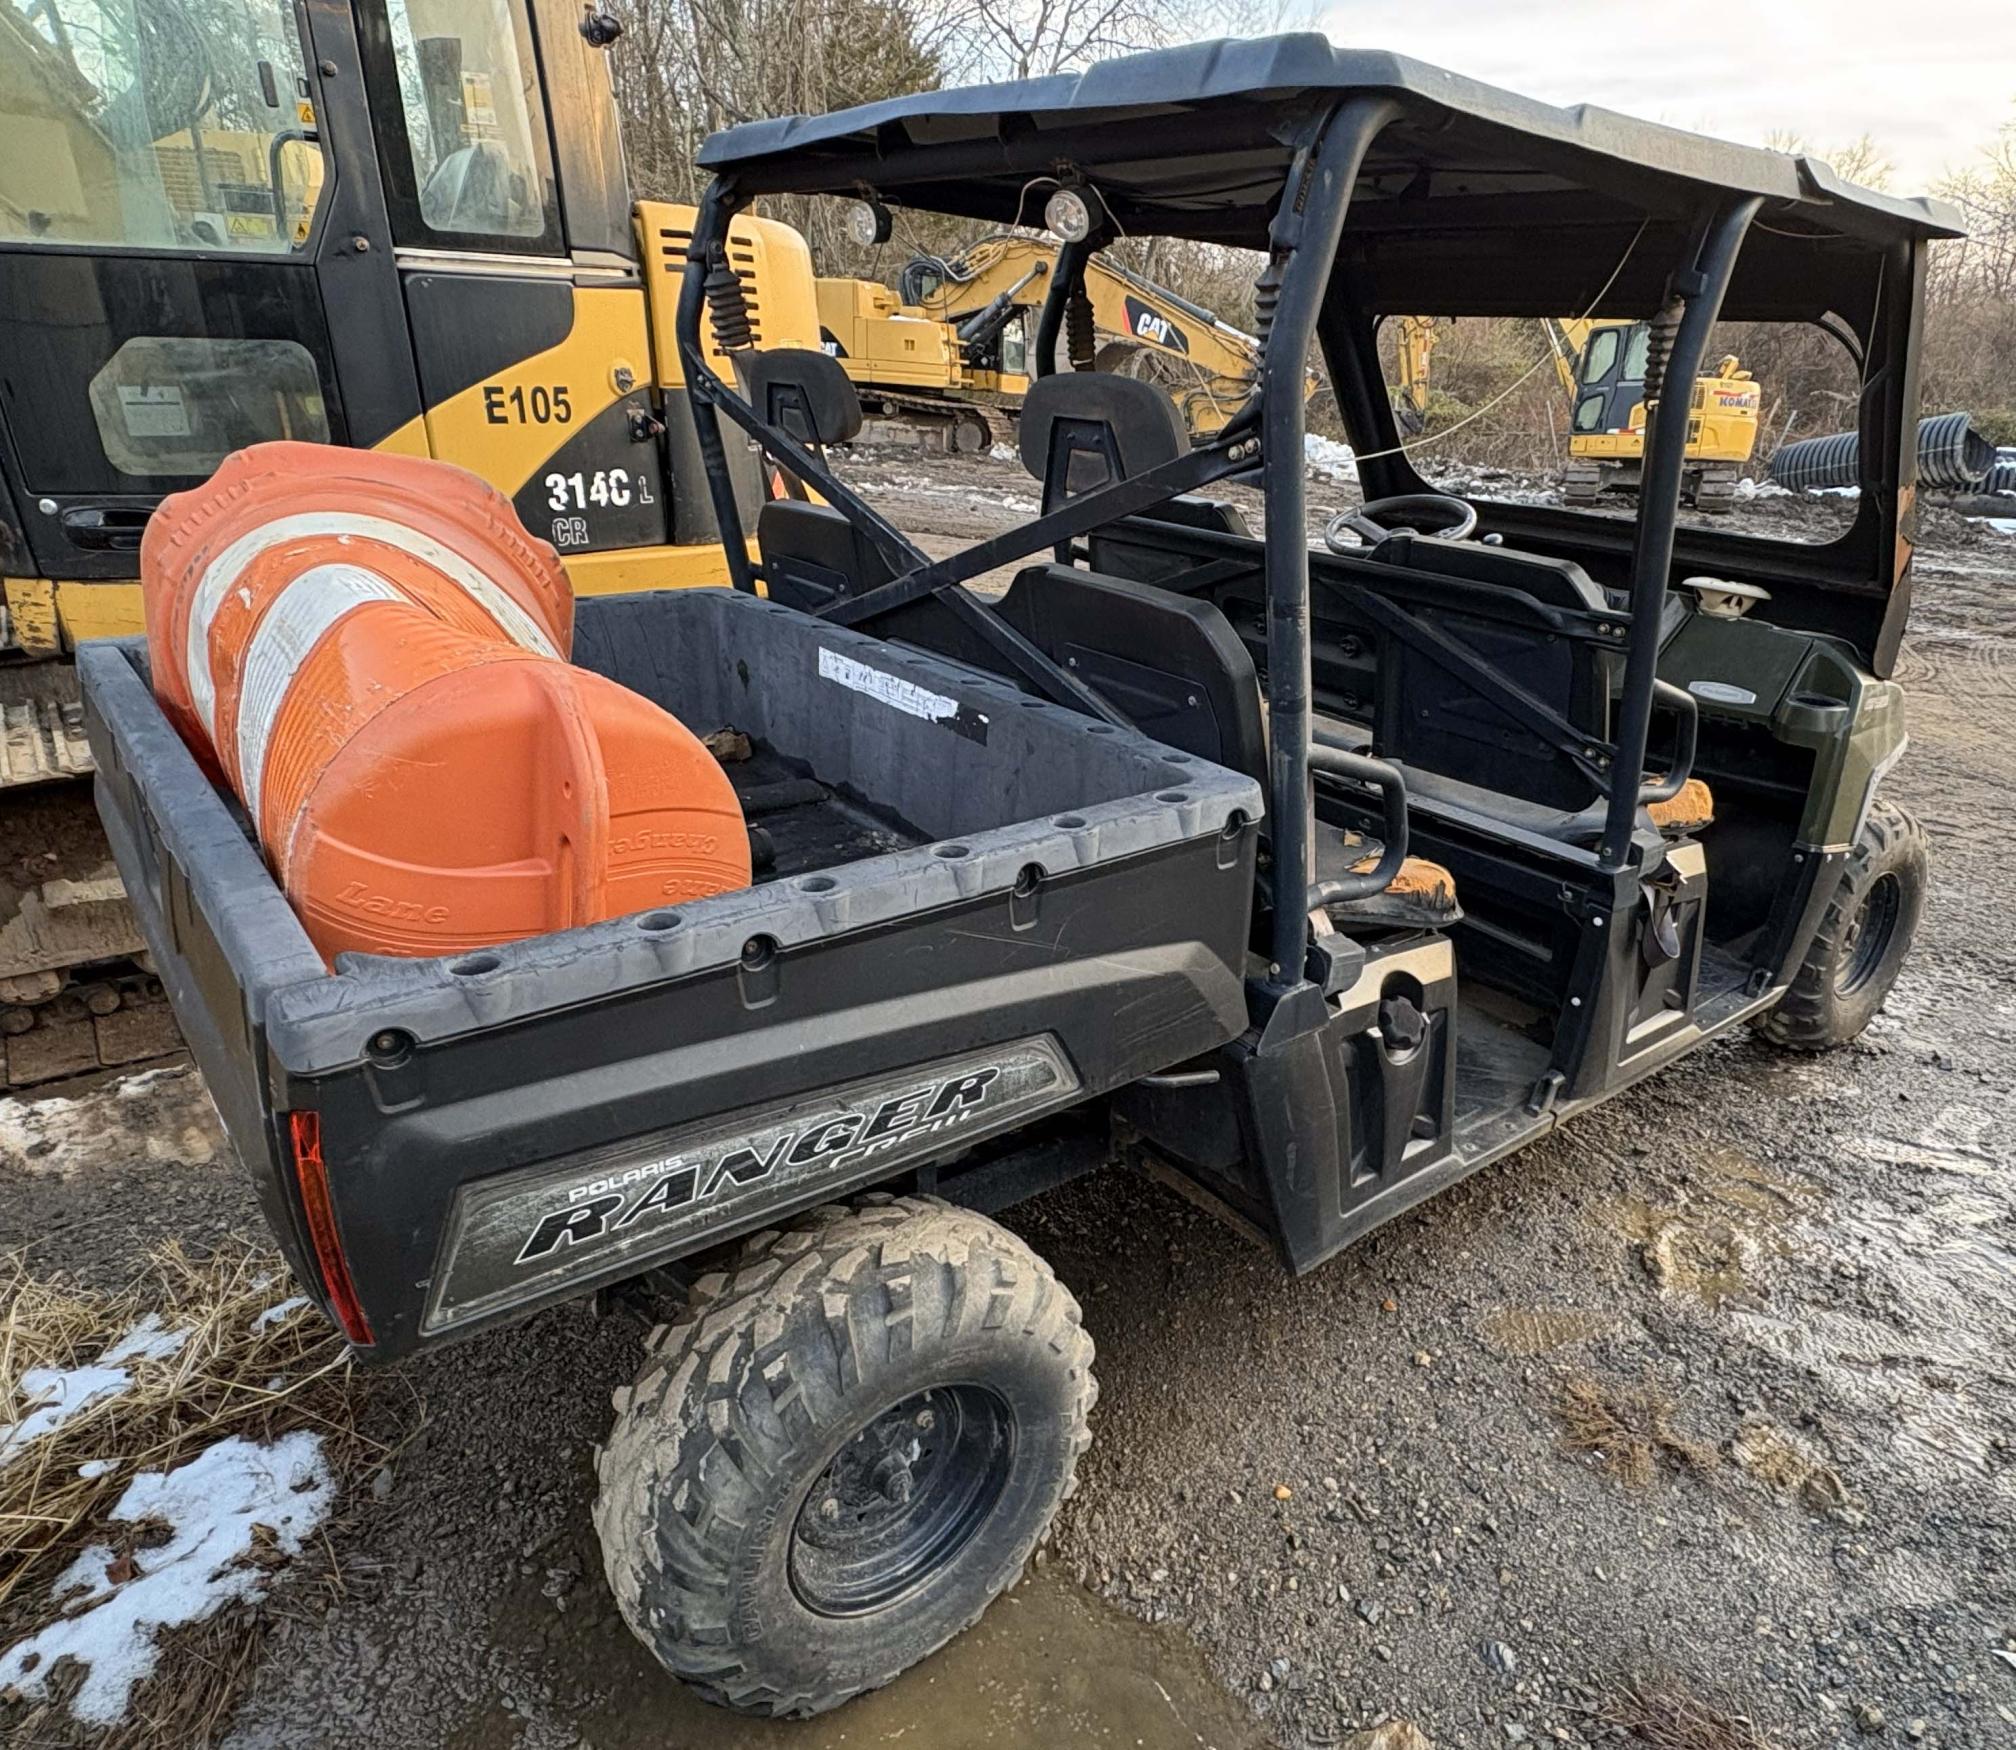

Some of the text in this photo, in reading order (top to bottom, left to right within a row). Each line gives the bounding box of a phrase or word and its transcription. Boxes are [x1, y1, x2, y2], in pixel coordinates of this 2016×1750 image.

[1136, 312, 1171, 344] CAT
[483, 385, 572, 425] E105
[1719, 396, 1757, 409] KOMAT
[545, 468, 654, 511] 314C L
[552, 516, 590, 546] CR
[335, 881, 450, 924] Lane
[513, 1066, 1000, 1265] RANGER
[568, 1154, 683, 1204] POLARIS
